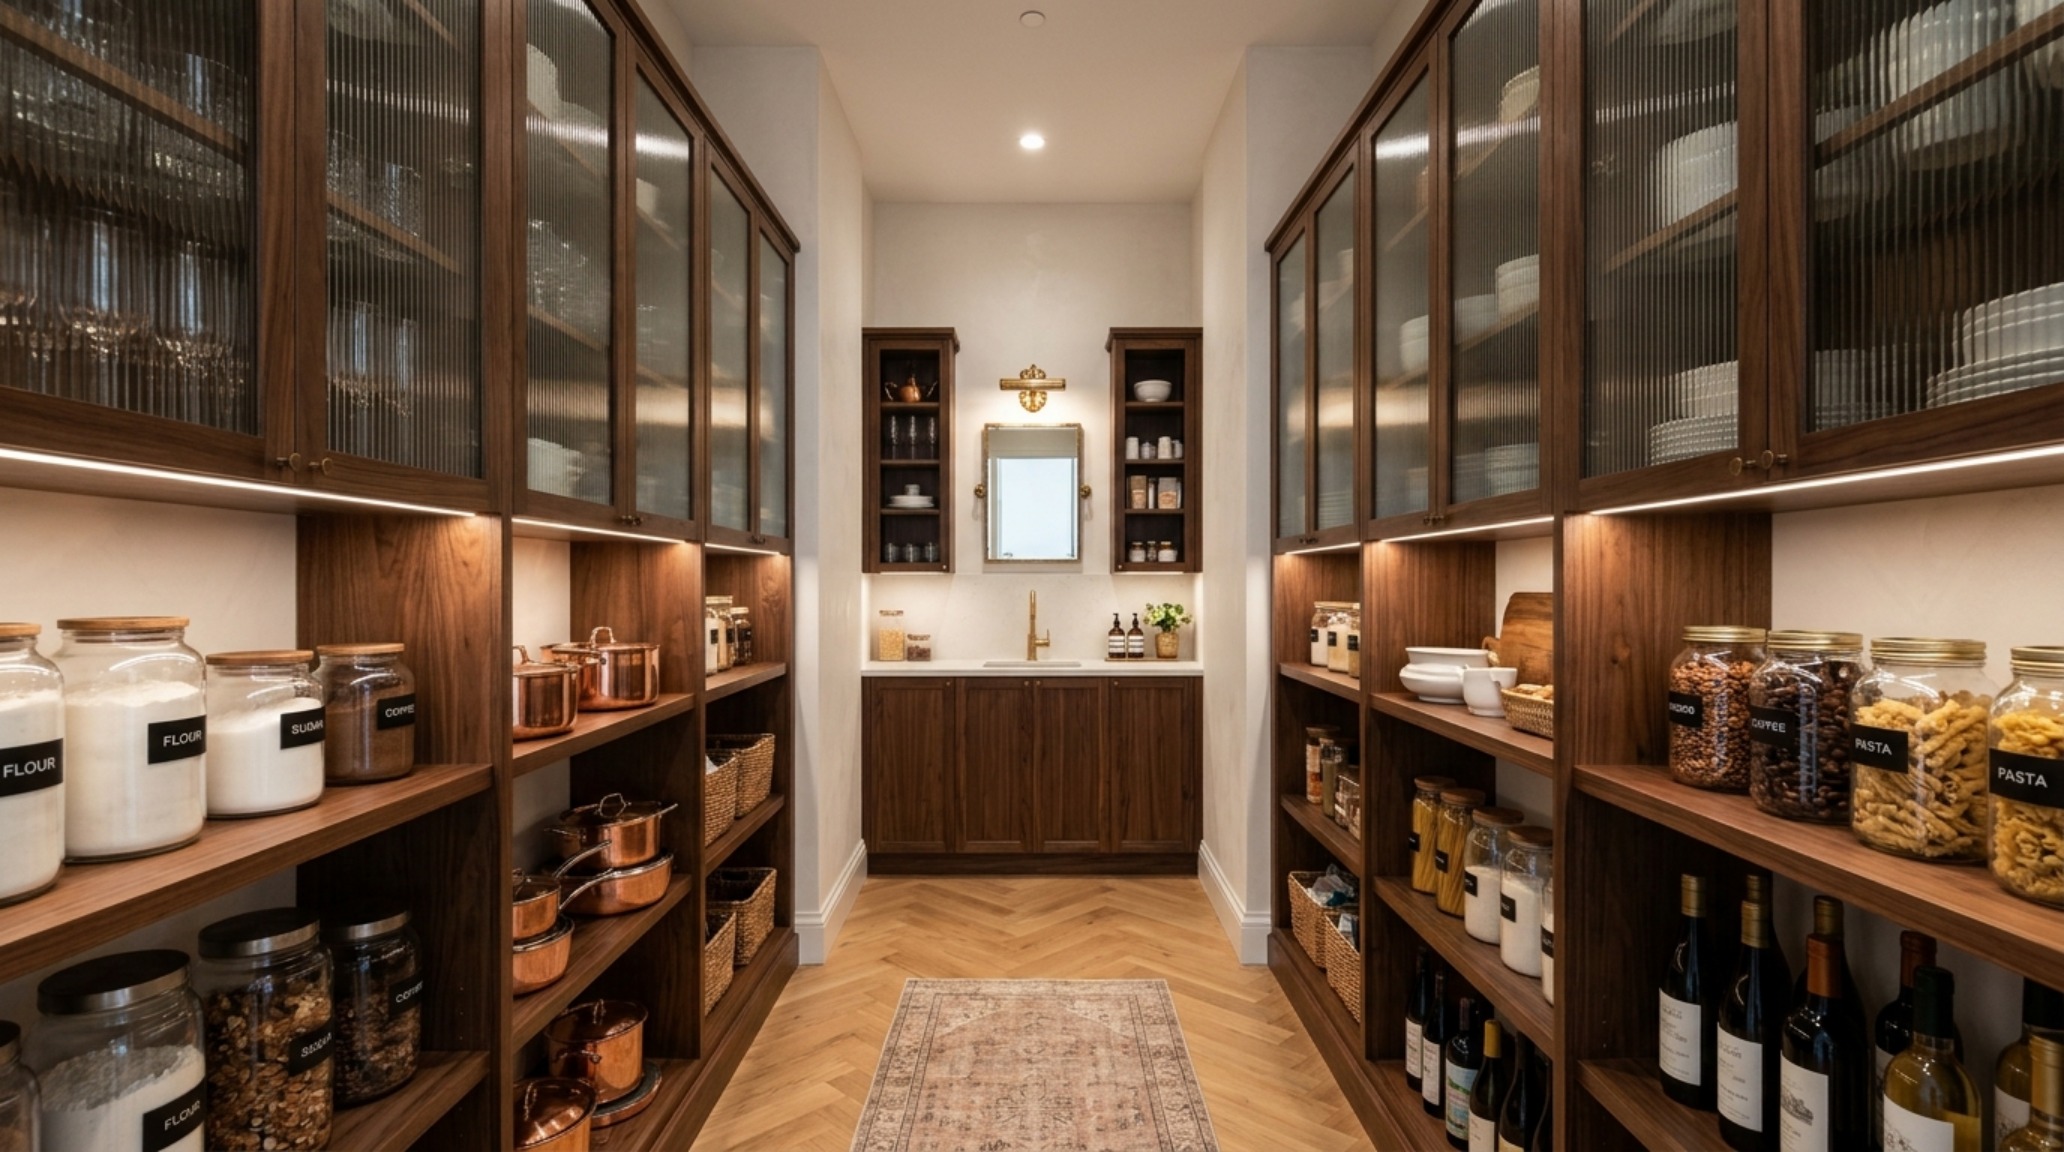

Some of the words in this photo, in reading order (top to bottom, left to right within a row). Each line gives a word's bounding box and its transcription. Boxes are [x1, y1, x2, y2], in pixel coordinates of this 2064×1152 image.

[163, 730, 202, 747] FLOUR
[1854, 737, 1893, 756] PASTA
[3, 756, 56, 778] FLOUR
[1997, 767, 2049, 788] PASTA
